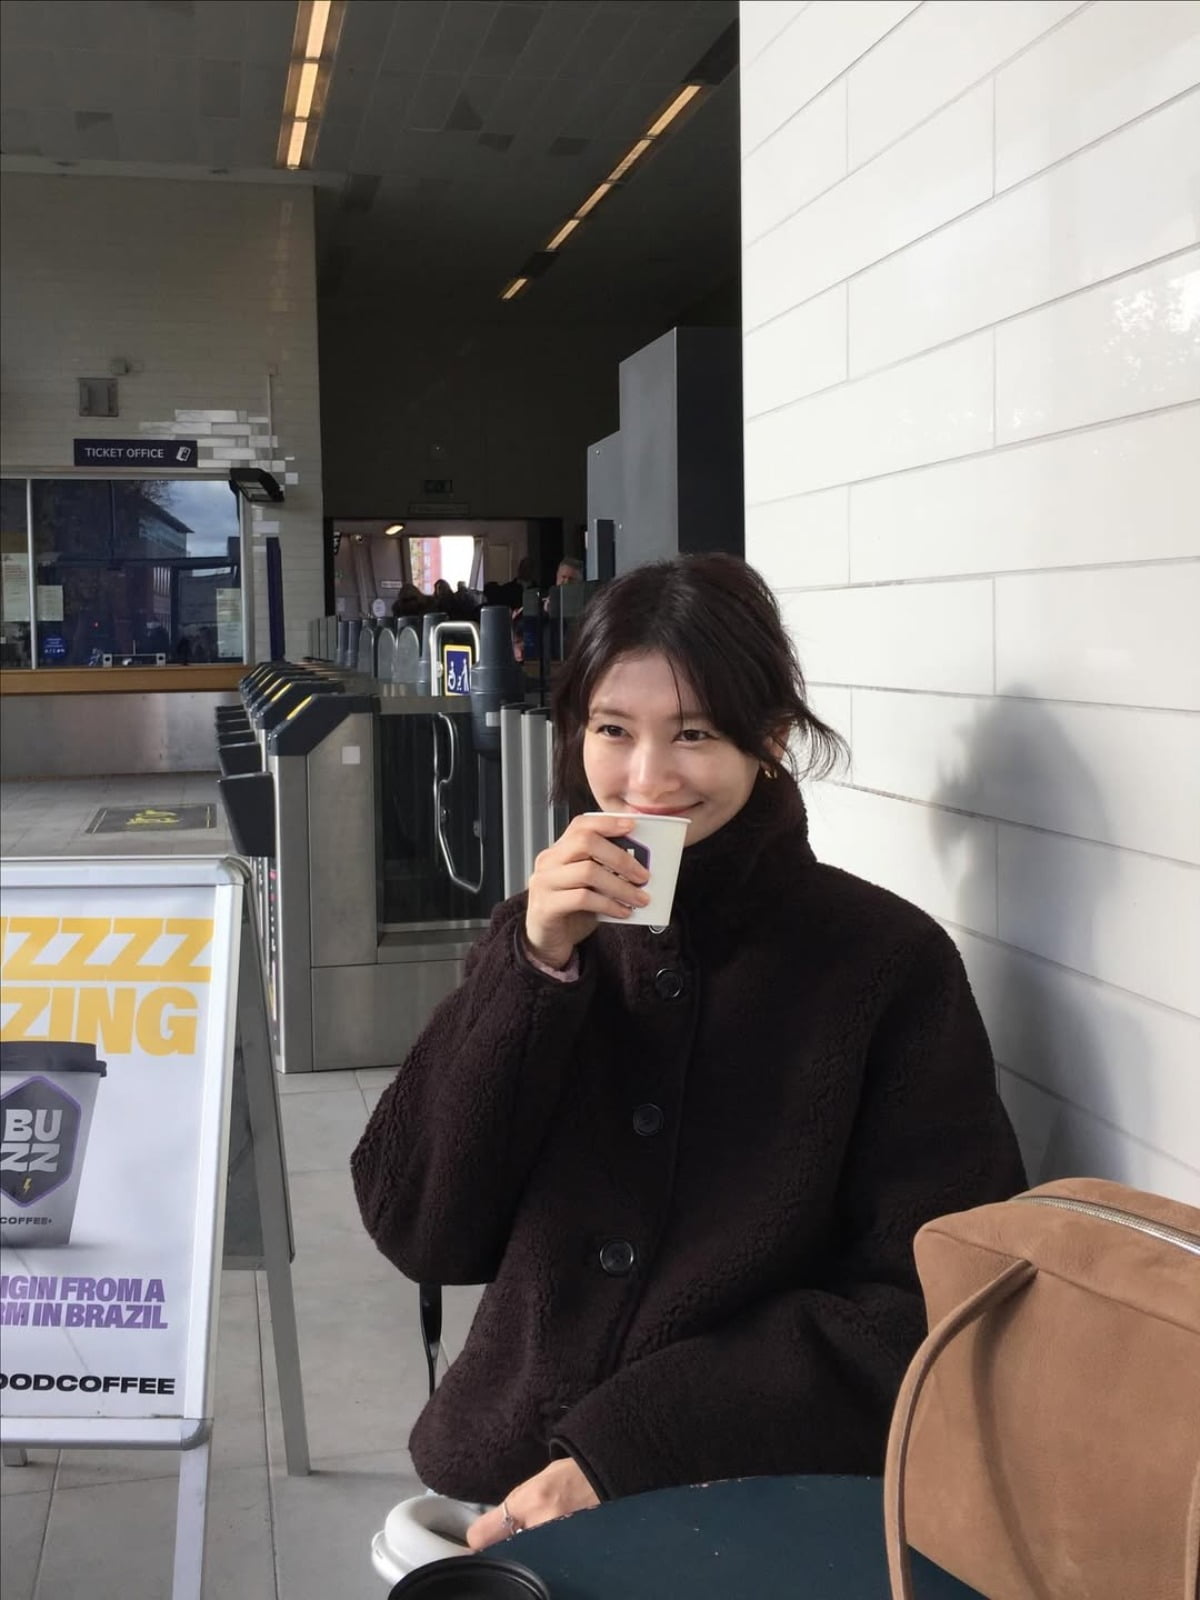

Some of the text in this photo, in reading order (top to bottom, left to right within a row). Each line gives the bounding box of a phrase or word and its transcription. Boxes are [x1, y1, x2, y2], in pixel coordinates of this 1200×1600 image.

[84, 447, 165, 459] TICKET OFFICE
[3, 1108, 63, 1142] BU
[0, 1142, 60, 1173] ZZ
[60, 1277, 143, 1303] FROM
[144, 1278, 166, 1303] A
[32, 1303, 62, 1328] IN
[65, 1303, 169, 1330] BRAZIL
